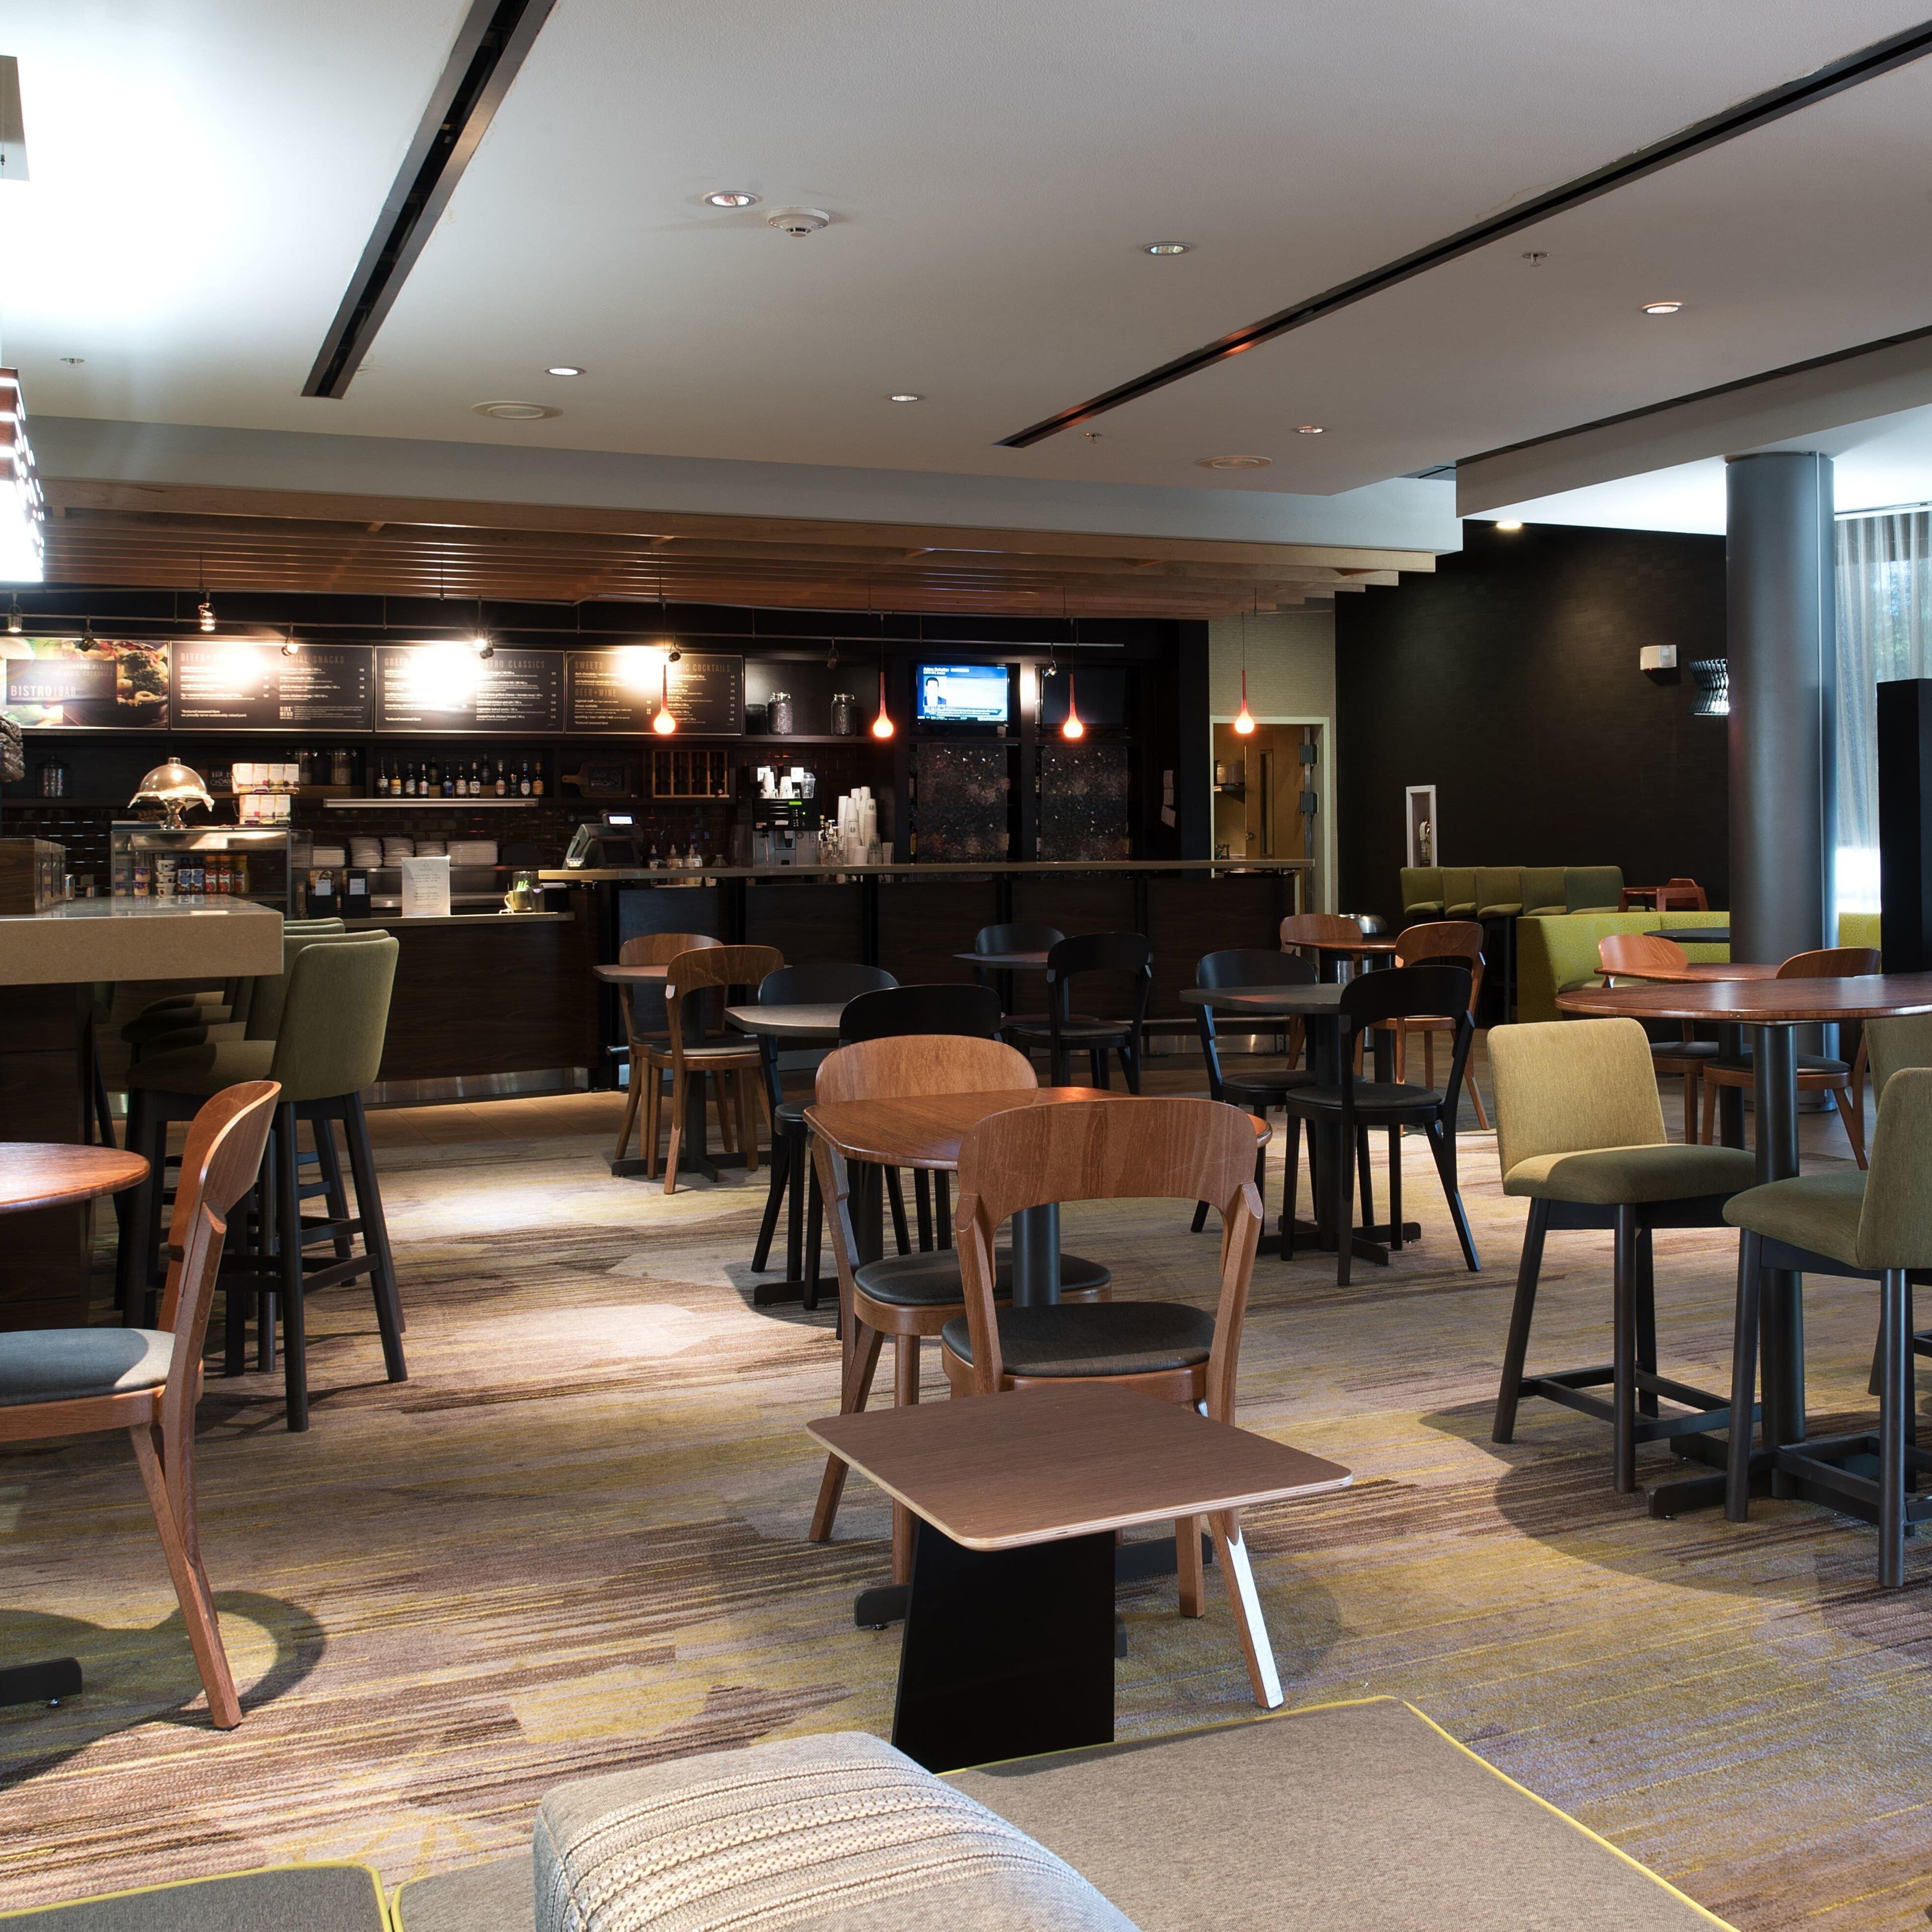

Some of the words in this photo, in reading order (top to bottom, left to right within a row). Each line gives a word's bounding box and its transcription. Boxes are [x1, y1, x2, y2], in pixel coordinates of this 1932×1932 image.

[313, 655, 345, 664] SNACKS
[508, 660, 545, 669] CLASSICS
[575, 661, 604, 669] SWEETS
[693, 664, 731, 673] COCKTAILS
[11, 685, 52, 697] BISTRO
[59, 685, 76, 697] BAR
